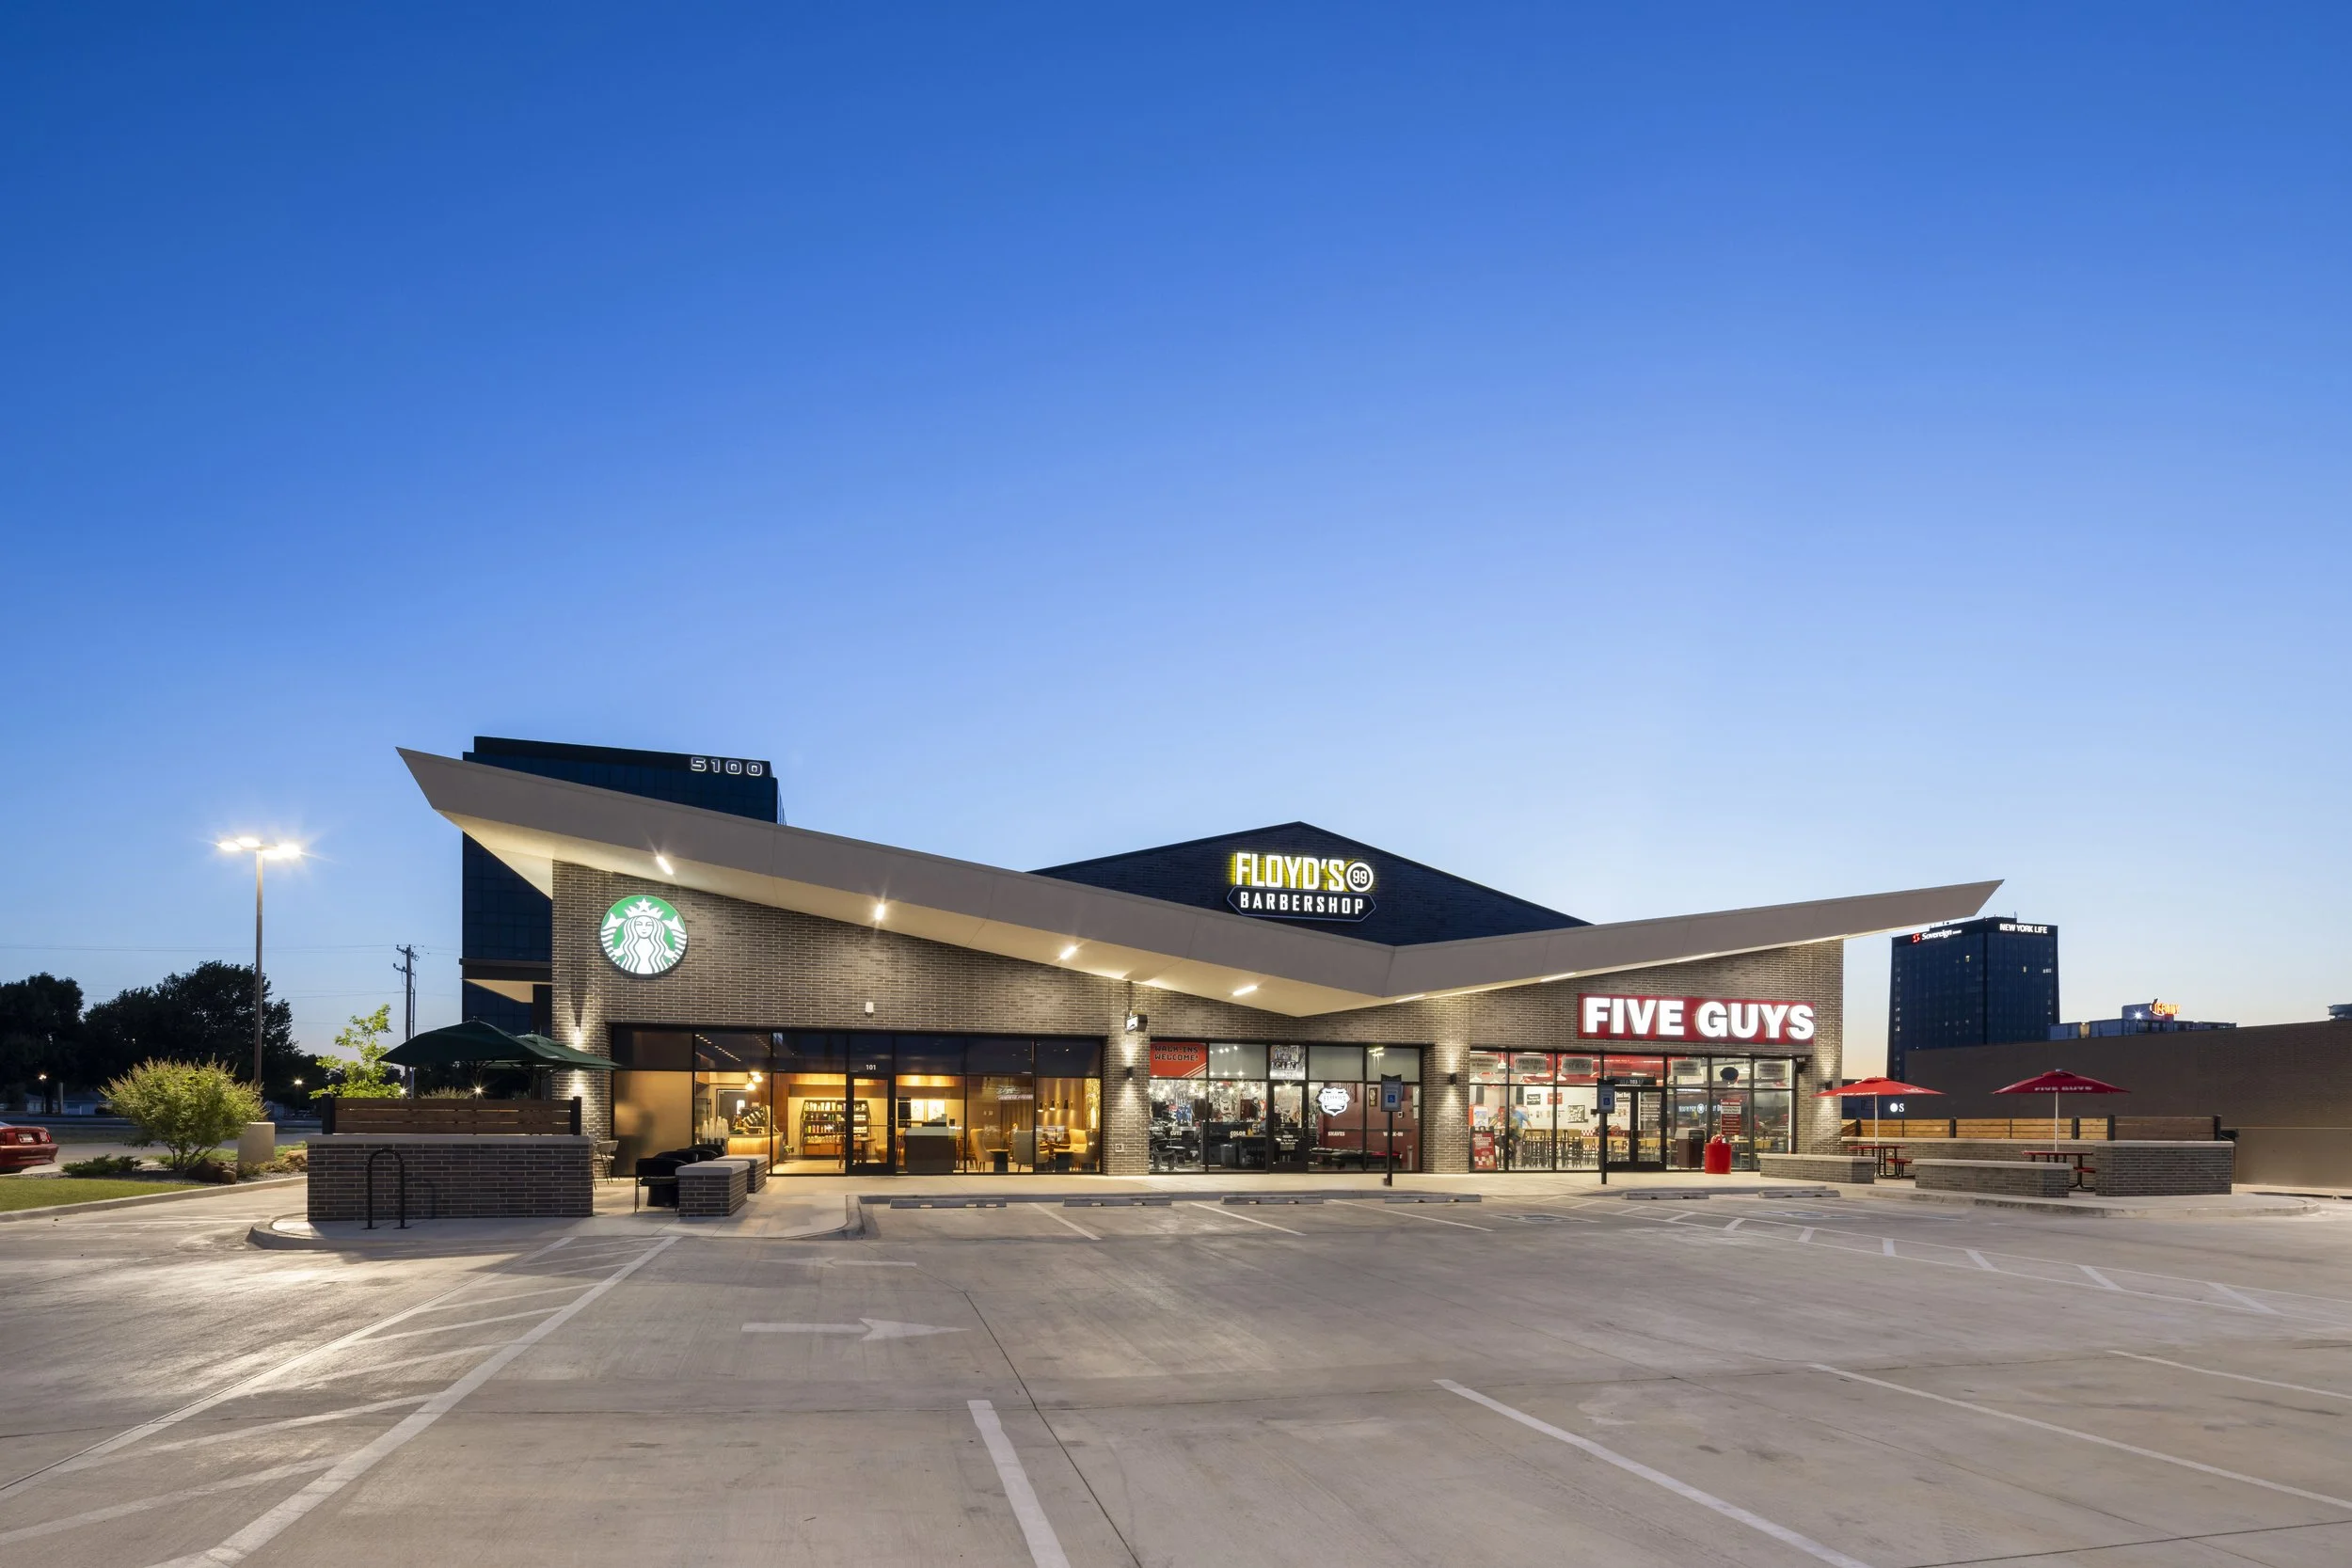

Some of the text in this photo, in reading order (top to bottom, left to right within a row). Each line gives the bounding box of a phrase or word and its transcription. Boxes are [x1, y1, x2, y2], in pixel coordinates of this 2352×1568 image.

[691, 756, 763, 777] 5100
[1235, 851, 1368, 893] FLOYD'S 99
[1240, 891, 1364, 915] BARBERSHOP
[1921, 929, 1952, 941] Sovereign
[1999, 923, 2048, 934] NEW YORK LIFE
[1582, 996, 1816, 1041] FIVE GUYS
[1154, 1045, 1198, 1053] WALK-INS
[1154, 1053, 1199, 1062] WELCOME!
